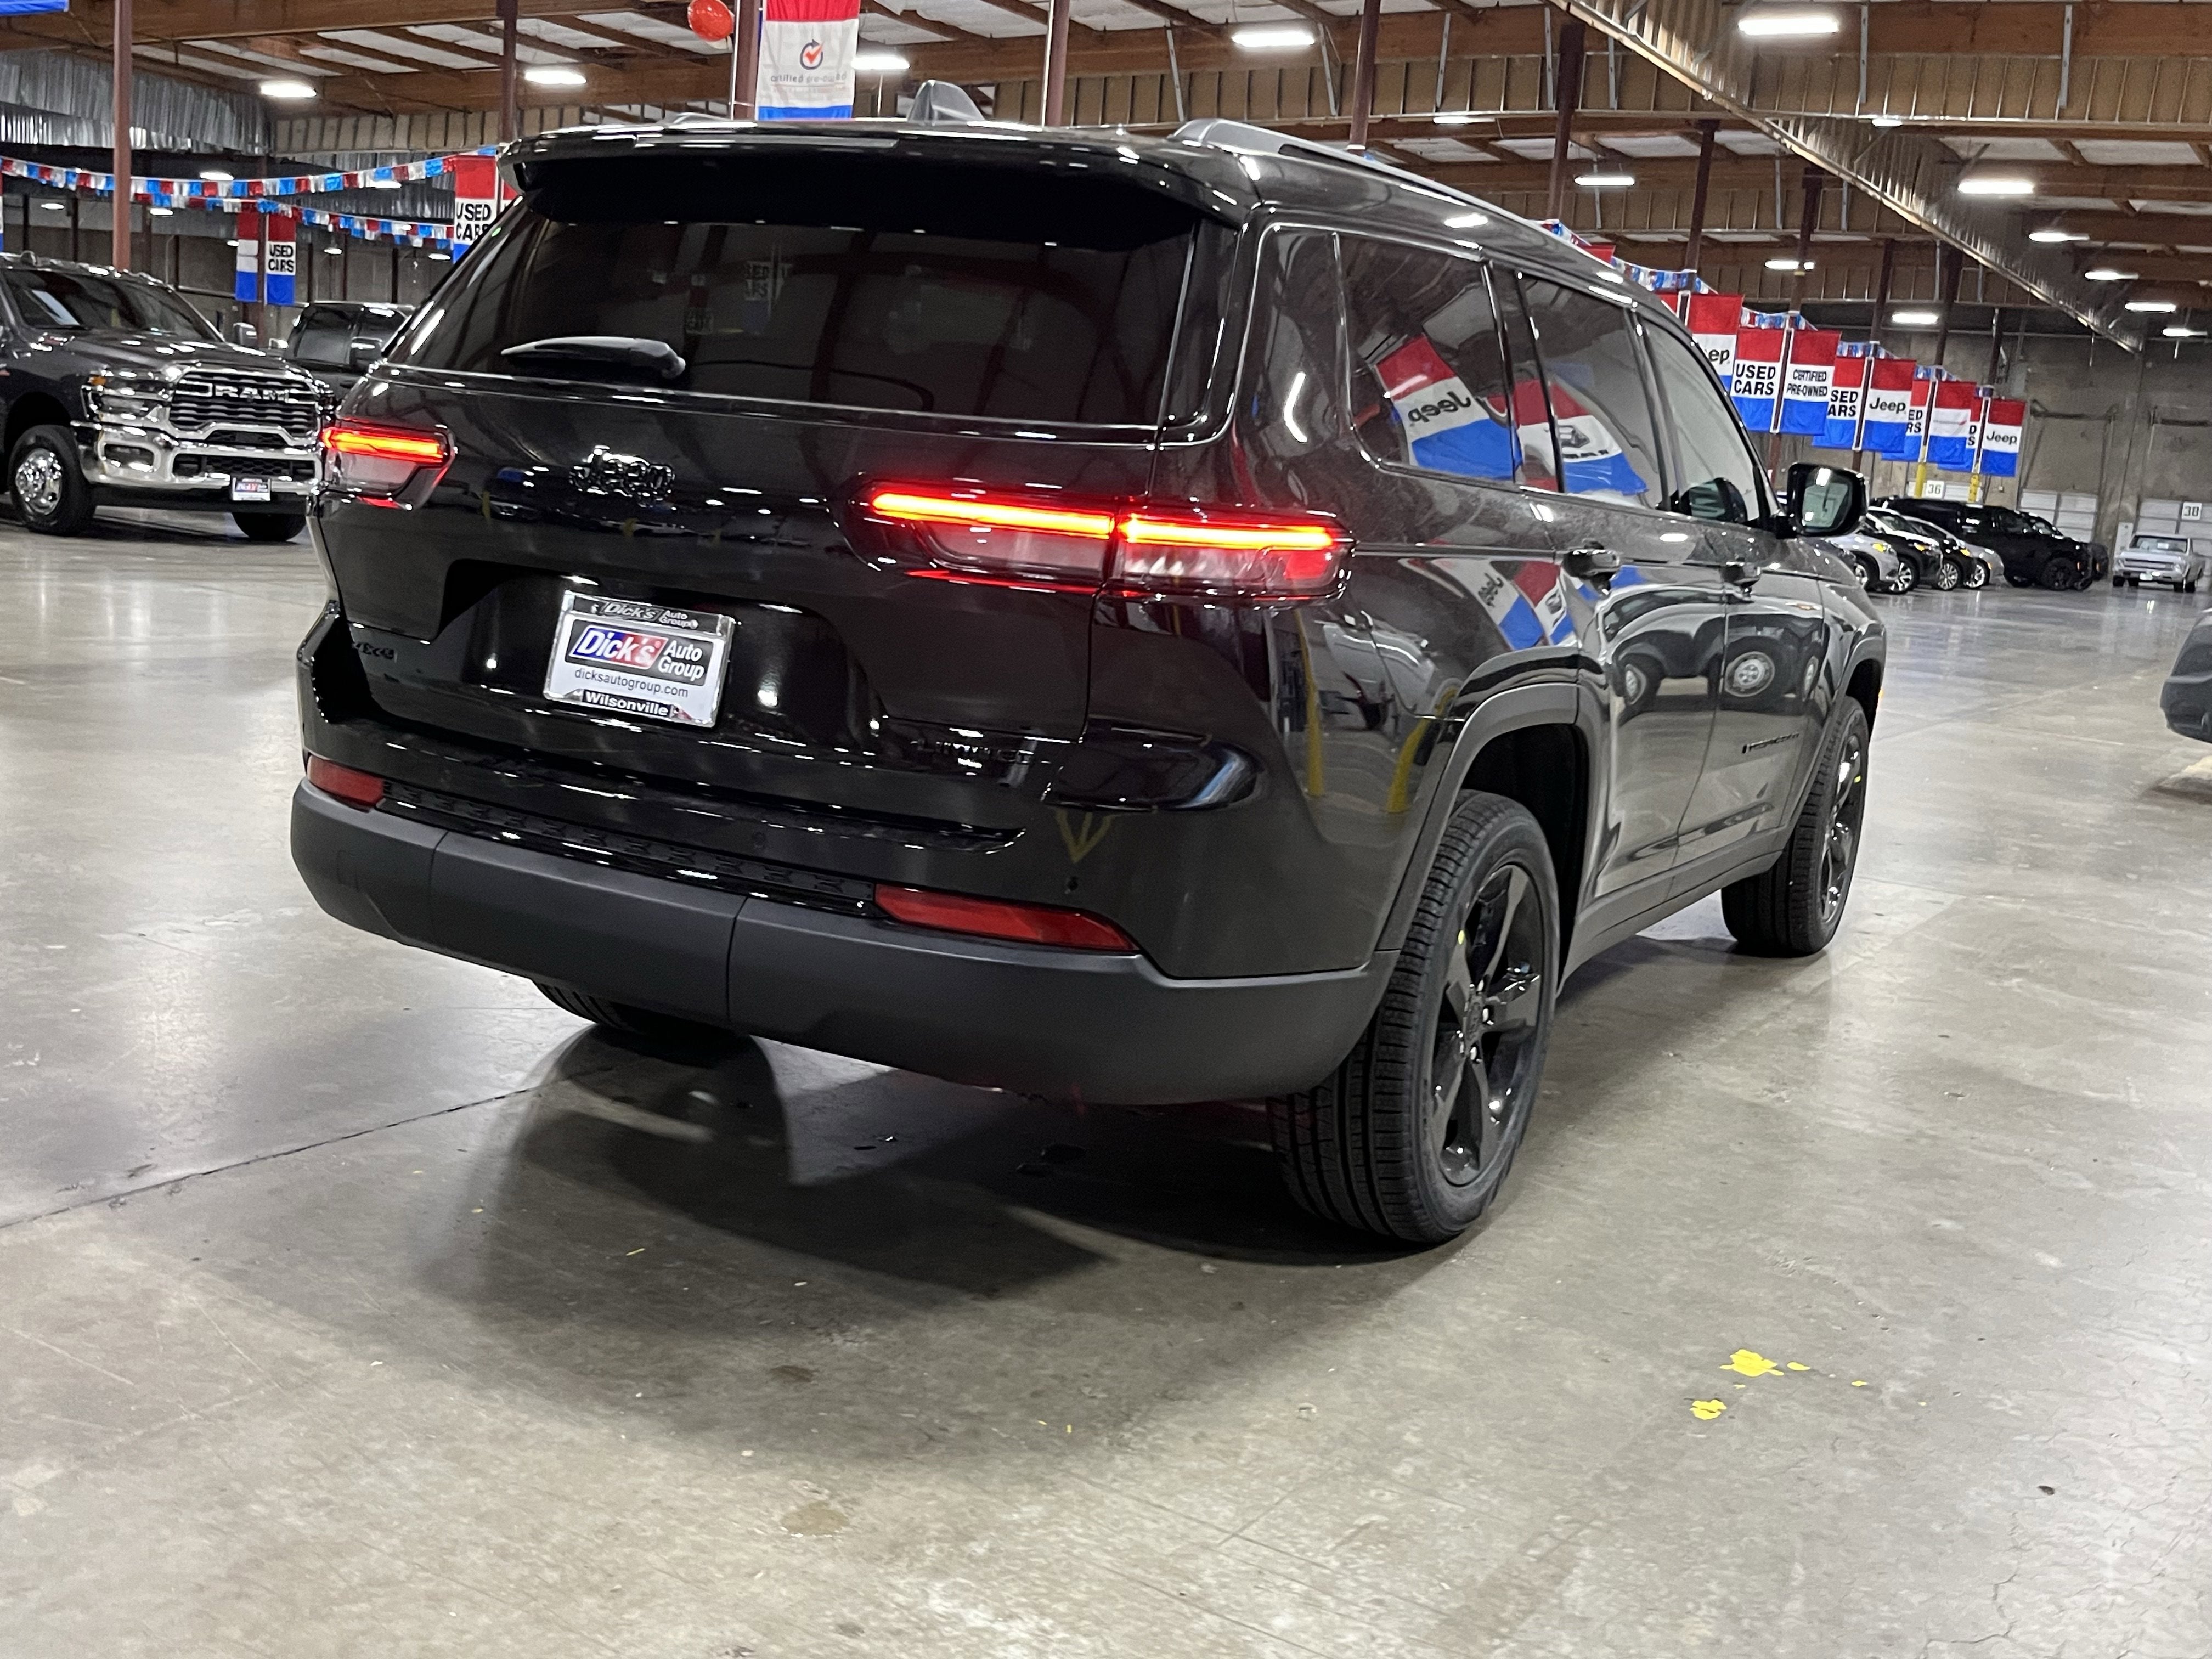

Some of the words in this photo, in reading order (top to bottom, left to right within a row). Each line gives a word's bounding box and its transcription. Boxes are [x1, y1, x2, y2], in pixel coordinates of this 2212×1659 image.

[456, 202, 492, 221] USED
[269, 243, 294, 257] USED
[1736, 363, 1776, 380] USED
[215, 385, 287, 401] RAM
[1734, 380, 1774, 395] CARS
[1830, 390, 1858, 403] SED
[1827, 404, 1857, 417] ARS
[1869, 397, 1906, 414] Jeep
[1986, 431, 2017, 445] Jeep
[1928, 484, 1941, 494] 36
[604, 602, 656, 621] Dick's
[661, 610, 688, 619] Auto
[577, 628, 654, 665] Dick's
[663, 640, 702, 661] Auto
[658, 656, 705, 681] Group
[574, 668, 689, 698] dicksautogroup.com
[585, 690, 669, 716] Wilsonville
